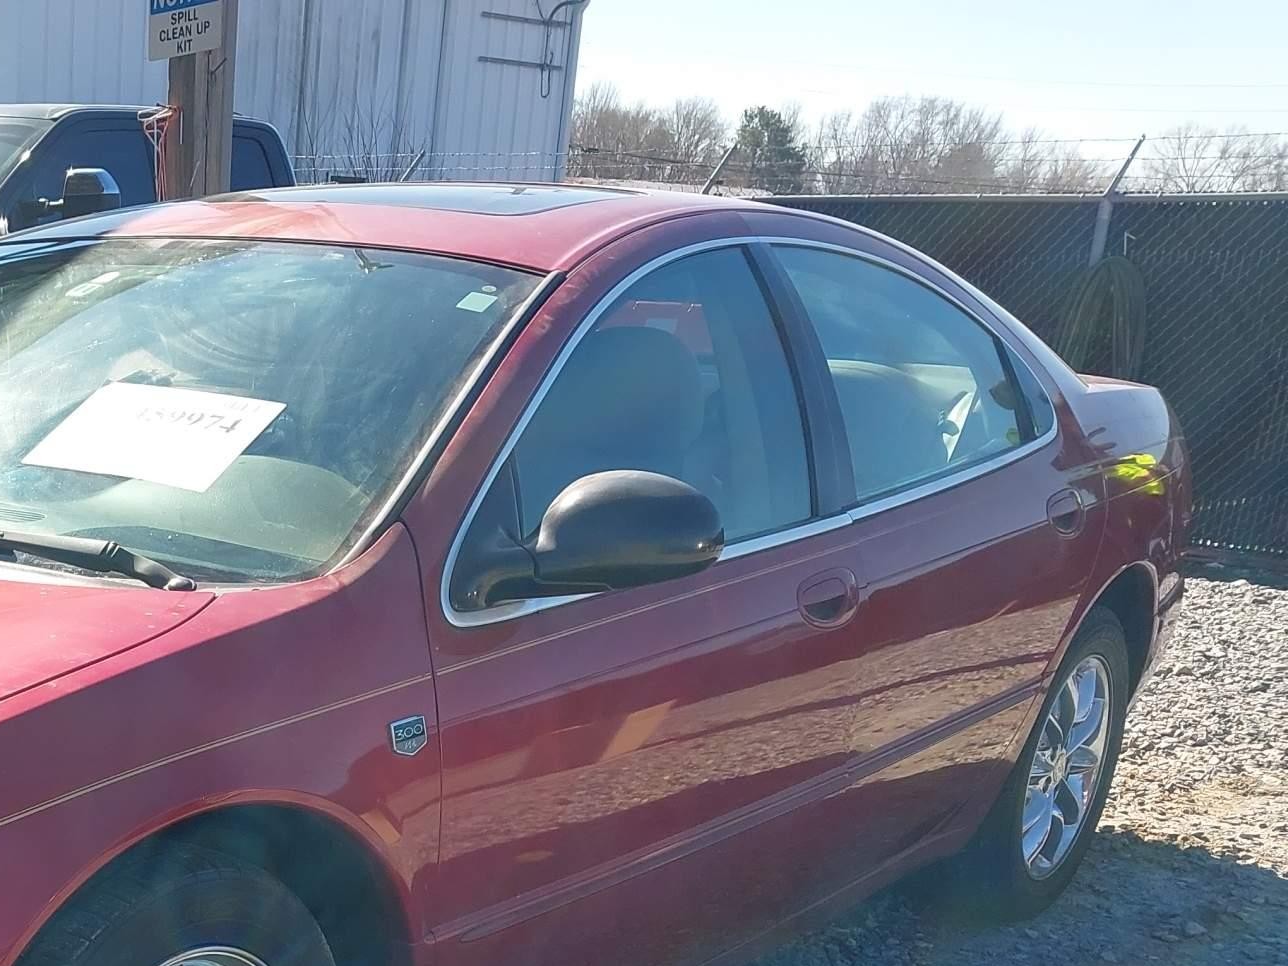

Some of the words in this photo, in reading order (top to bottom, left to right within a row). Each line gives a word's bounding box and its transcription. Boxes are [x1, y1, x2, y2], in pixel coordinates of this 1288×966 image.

[171, 8, 198, 25] SPILL
[159, 24, 192, 42] CLEAN
[196, 21, 210, 35] UP
[177, 38, 193, 54] KIT
[396, 724, 423, 741] 300
